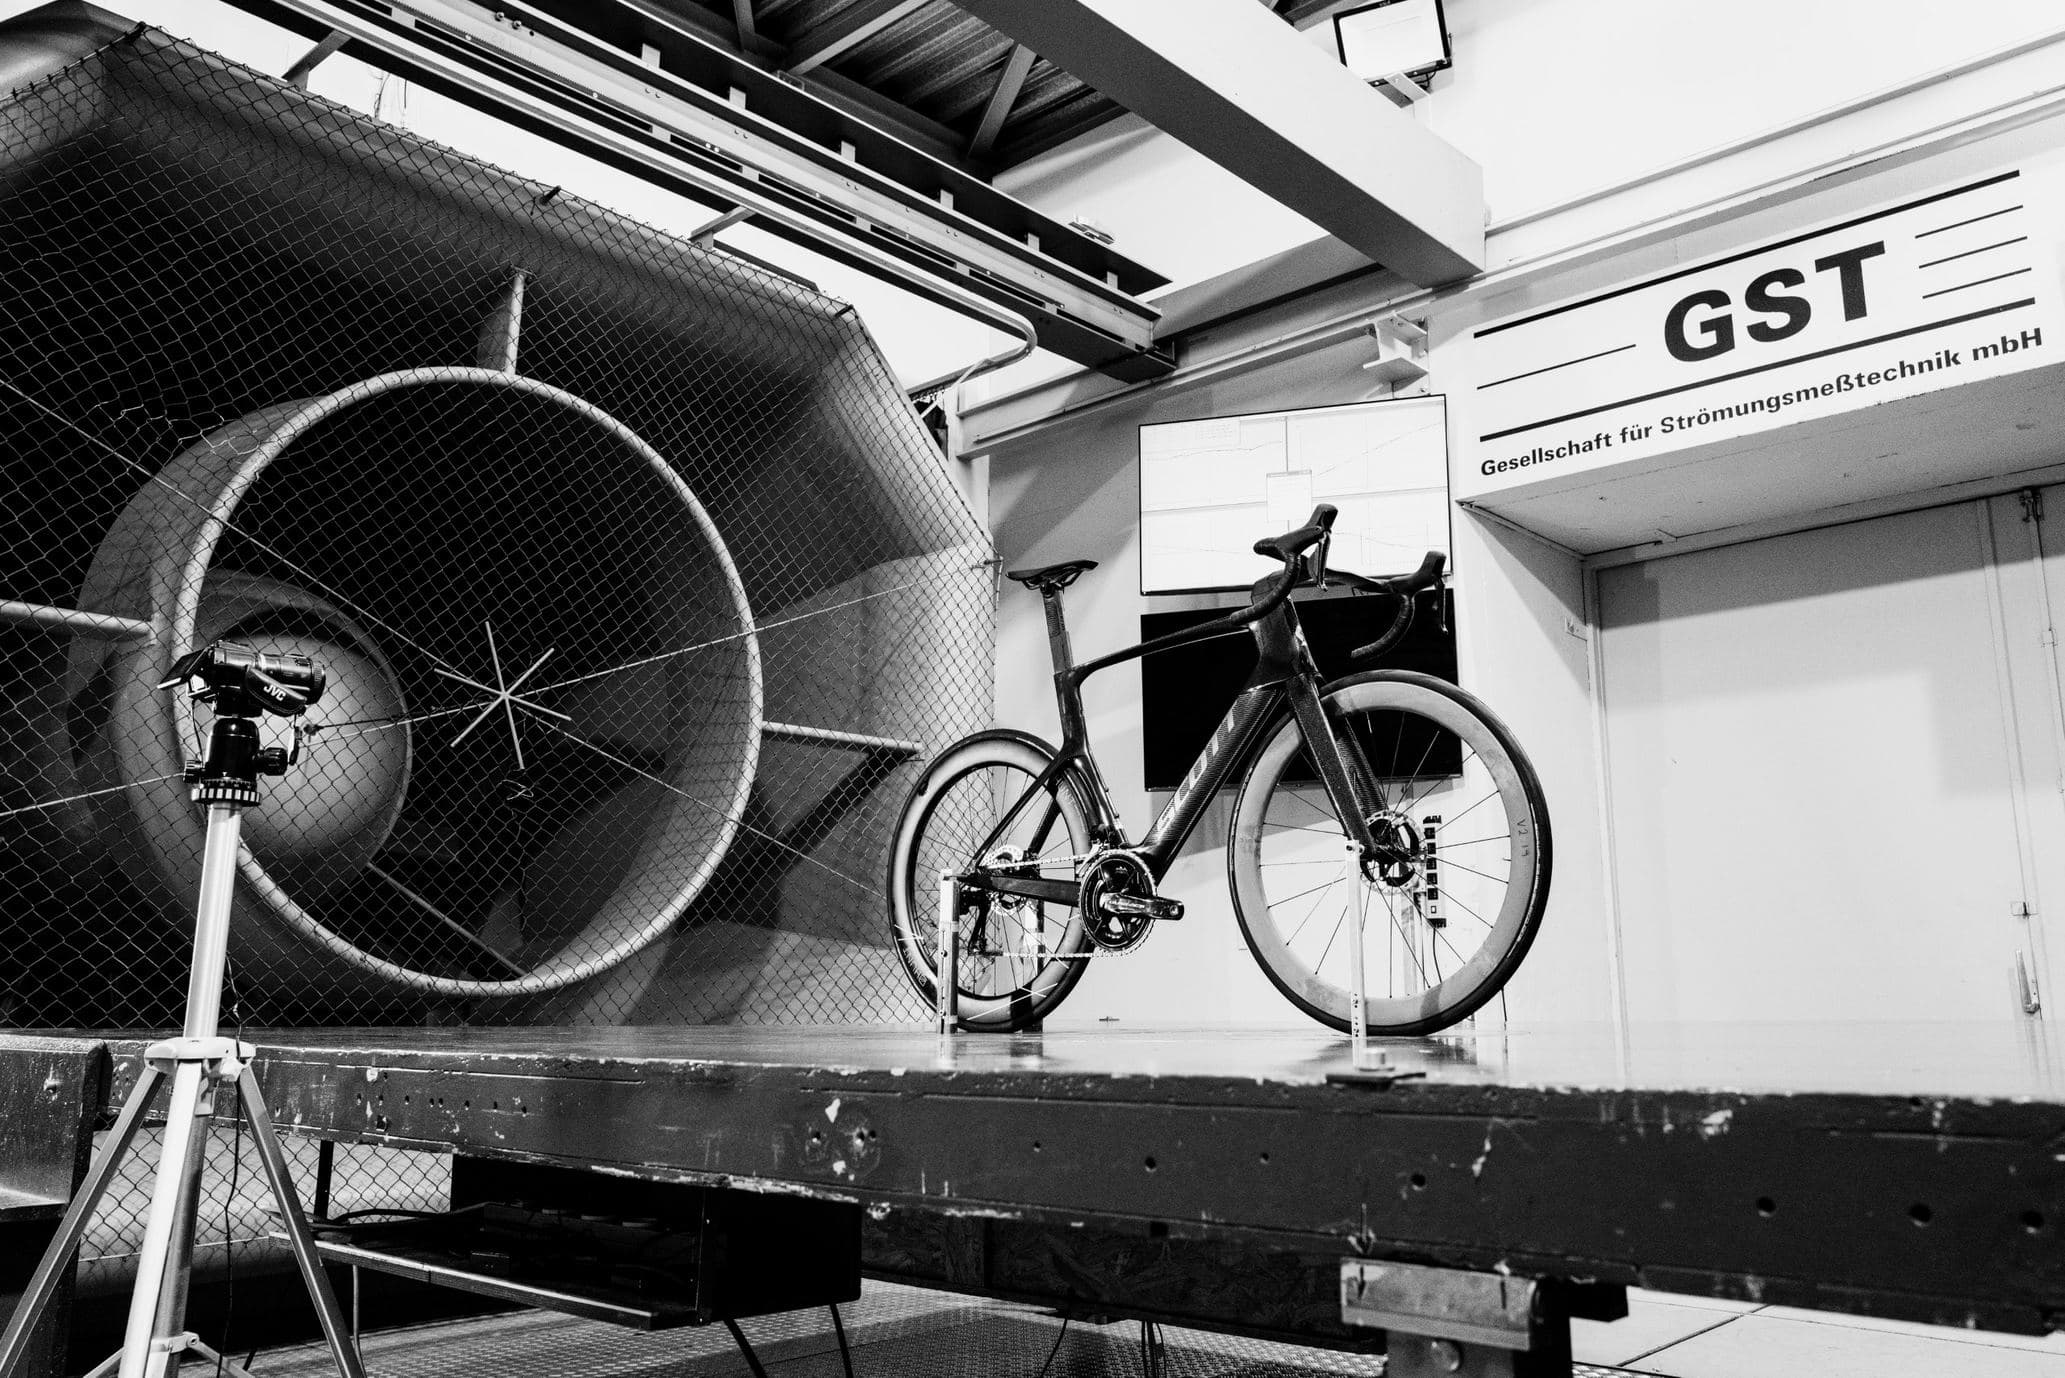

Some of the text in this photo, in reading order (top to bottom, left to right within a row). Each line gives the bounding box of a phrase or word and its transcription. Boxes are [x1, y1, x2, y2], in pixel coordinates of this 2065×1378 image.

[1664, 240, 1886, 362] GST
[1481, 327, 2043, 477] Gesellschaft für Strömungsmeßtechnik mbH
[263, 684, 287, 702] JVC
[1157, 700, 1236, 834] SCOTT
